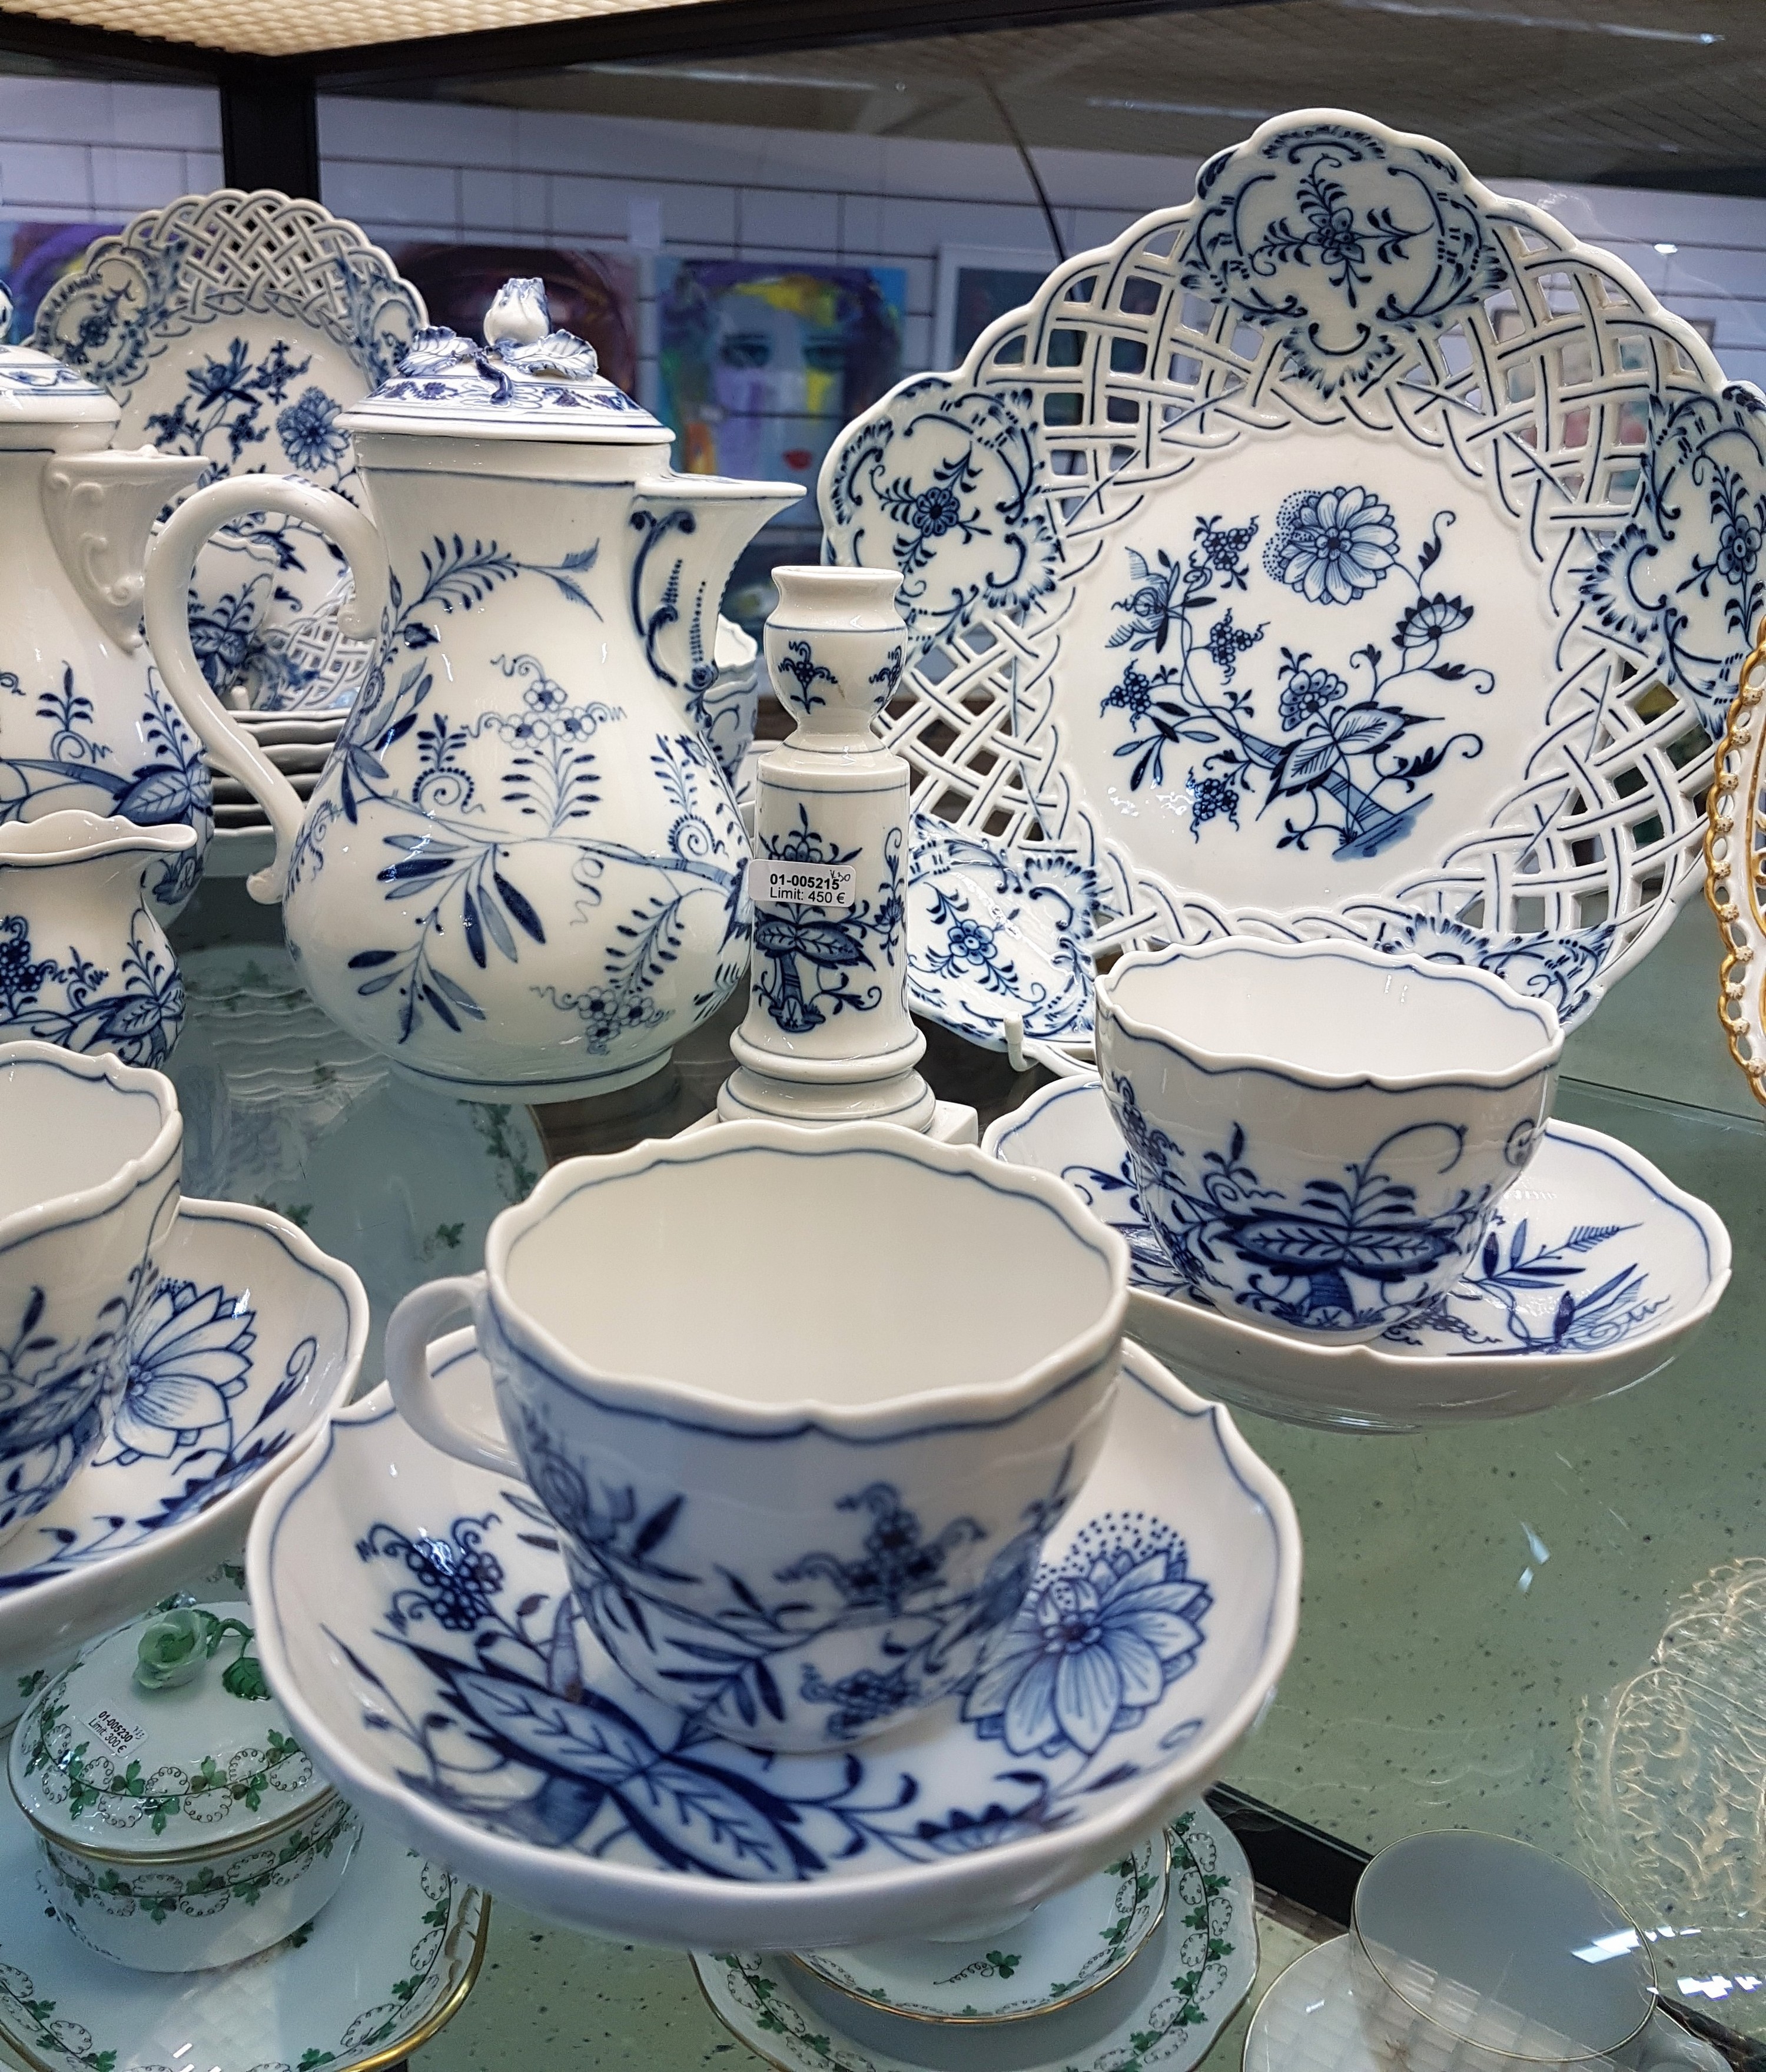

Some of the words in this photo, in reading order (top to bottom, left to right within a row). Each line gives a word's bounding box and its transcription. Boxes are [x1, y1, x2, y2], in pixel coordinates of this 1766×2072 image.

[770, 873, 839, 890] 01-005215
[770, 887, 804, 901] Limit:
[808, 891, 832, 903] 450
[836, 892, 845, 904] €
[98, 1711, 133, 1742] 01-005230
[105, 1733, 121, 1748] 300
[117, 1745, 127, 1753] €
